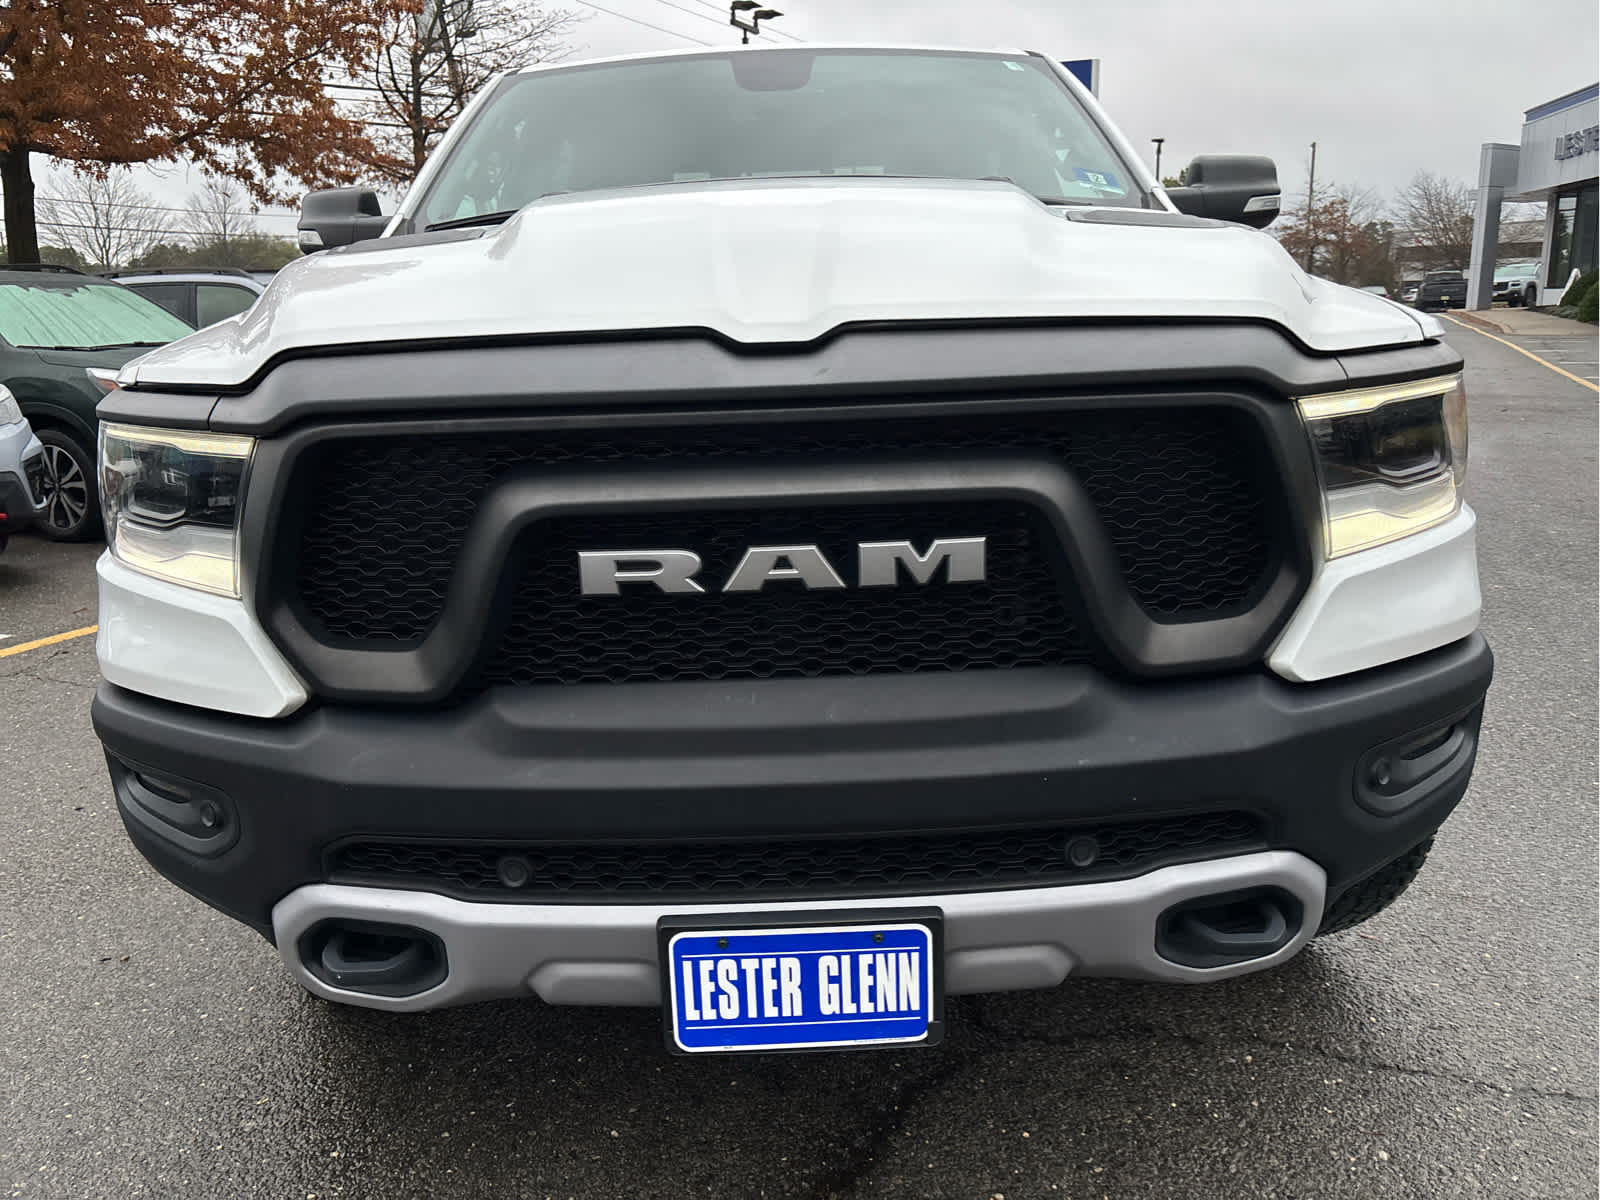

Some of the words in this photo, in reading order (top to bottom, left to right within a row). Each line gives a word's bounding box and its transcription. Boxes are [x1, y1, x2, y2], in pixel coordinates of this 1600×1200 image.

[578, 537, 986, 595] RAM
[682, 957, 803, 1021] LESTER
[818, 952, 920, 1016] GLENN
